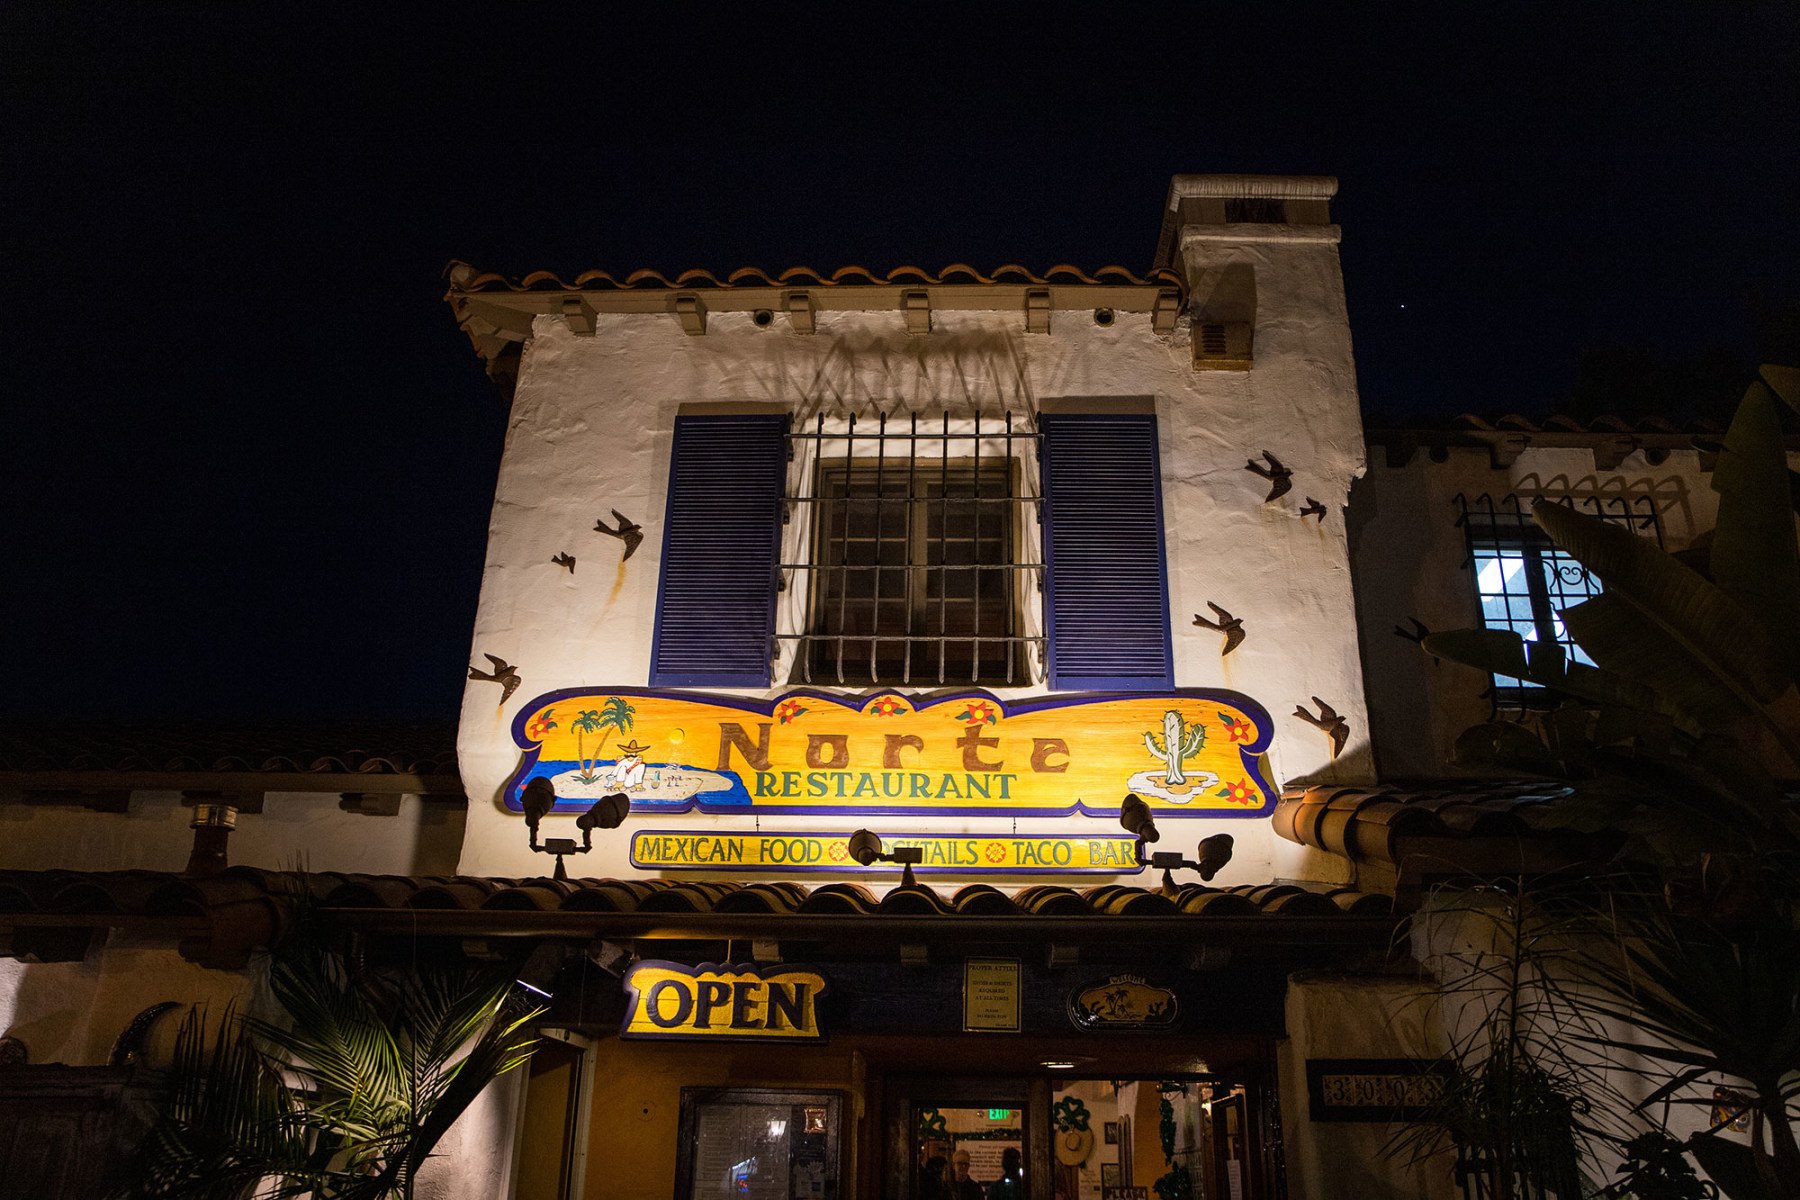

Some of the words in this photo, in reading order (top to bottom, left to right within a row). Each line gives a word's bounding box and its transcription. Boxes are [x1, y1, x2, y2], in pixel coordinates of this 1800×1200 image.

[716, 722, 1070, 773] Norte
[755, 771, 1017, 799] RESTAURANT
[639, 837, 744, 862] MEXICAN
[759, 838, 822, 864] FOOD
[880, 840, 978, 865] TAILS
[1012, 841, 1072, 865] TACO
[1089, 841, 1135, 865] BAR
[646, 979, 808, 1030] OPEN
